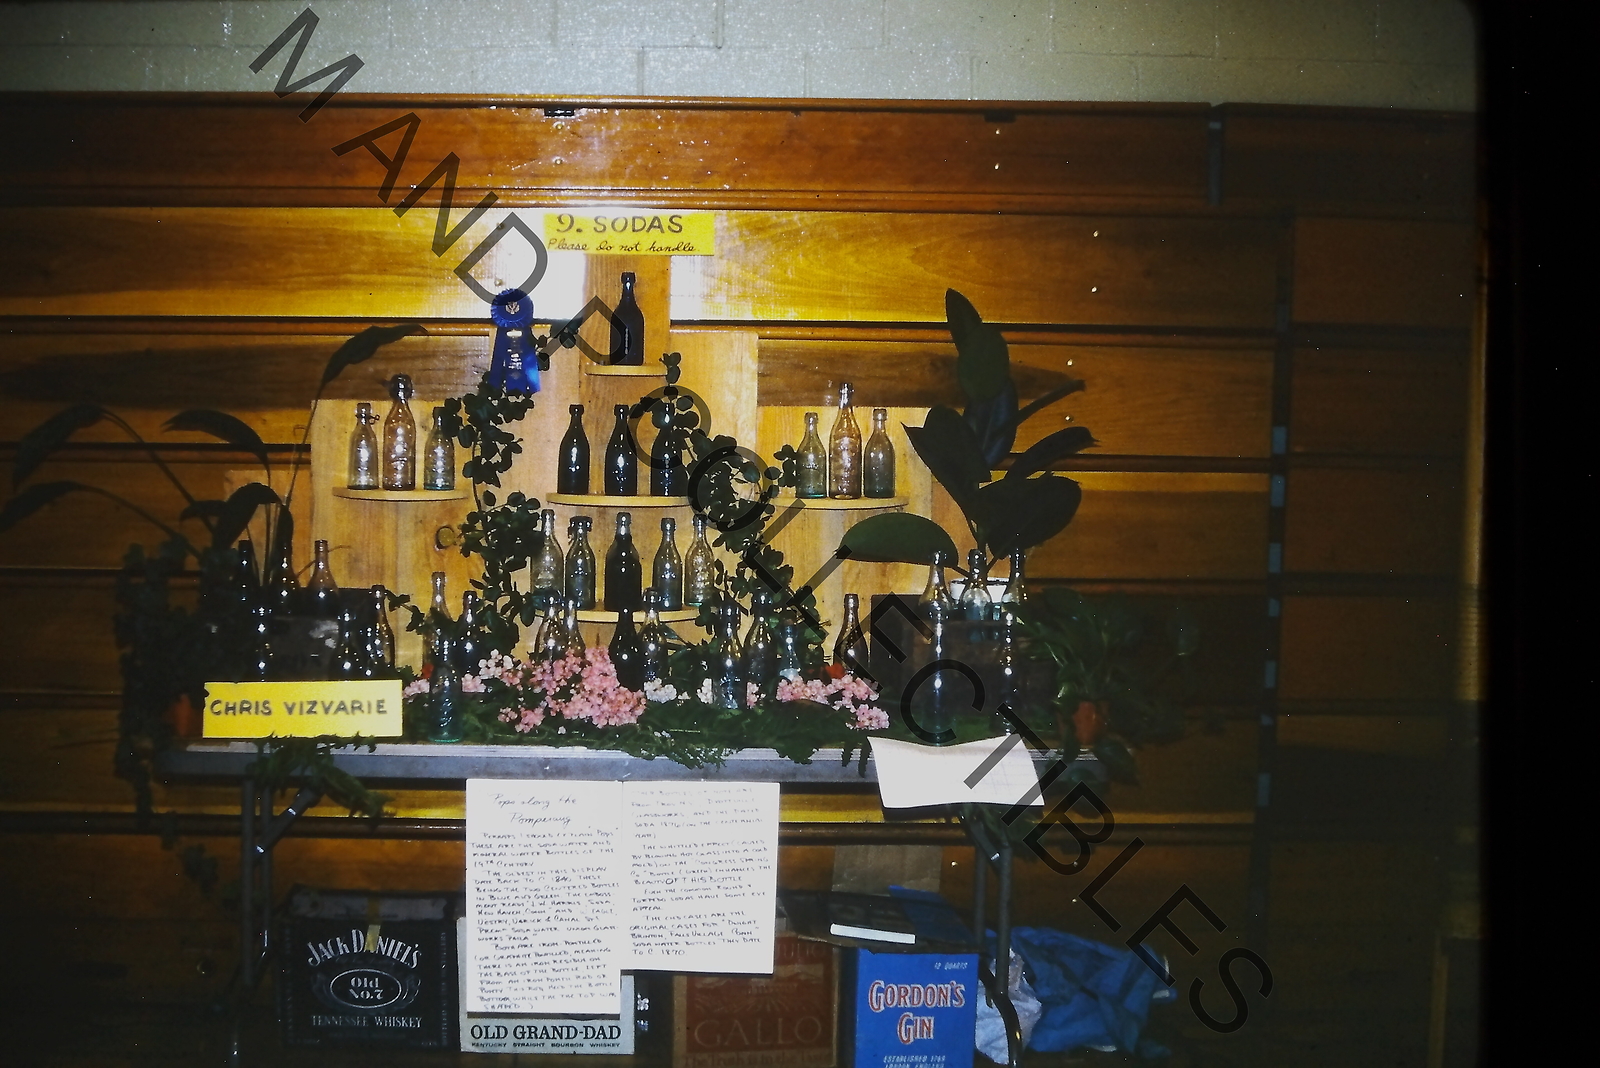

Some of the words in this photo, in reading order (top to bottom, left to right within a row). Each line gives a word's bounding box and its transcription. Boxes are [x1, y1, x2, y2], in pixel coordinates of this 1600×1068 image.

[593, 213, 684, 234] SODAS
[547, 238, 588, 251] Please
[619, 240, 641, 252] not
[210, 699, 273, 716] CHRIS
[284, 699, 388, 715] VIZVARIE
[307, 936, 350, 968] JACK
[350, 928, 422, 969] DNIEL'S
[350, 976, 380, 989] Old
[868, 979, 966, 1013] GORDON'S
[311, 1014, 370, 1028] TENNESSEE
[374, 1015, 422, 1029] WHISKEY
[897, 1011, 935, 1046] GIN
[470, 1024, 509, 1040] OLD
[512, 1024, 622, 1040] GRAND-DAD
[694, 1015, 822, 1048] GALLO
